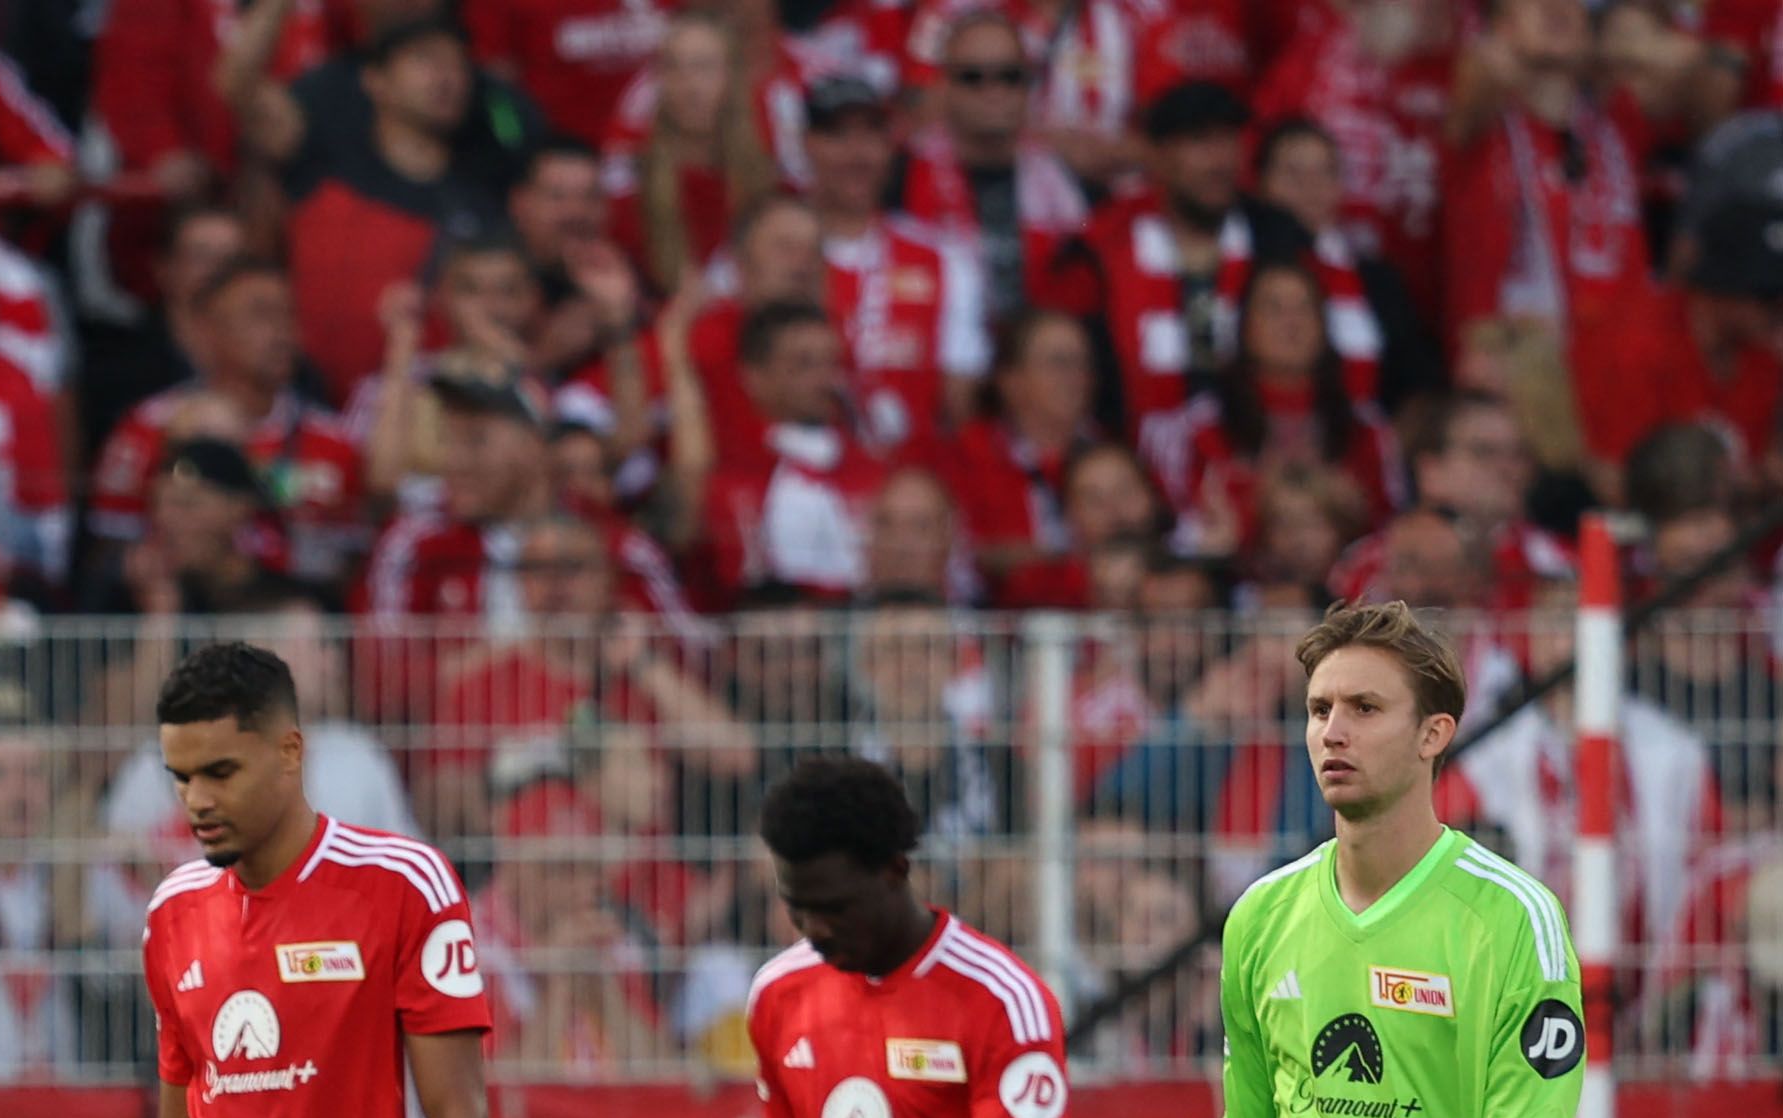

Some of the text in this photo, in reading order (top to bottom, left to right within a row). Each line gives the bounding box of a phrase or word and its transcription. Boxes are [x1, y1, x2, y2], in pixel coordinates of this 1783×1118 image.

[436, 938, 477, 980] JD
[1414, 987, 1446, 1007] UNION
[1528, 1016, 1576, 1060] JD
[1012, 1072, 1057, 1107] JD
